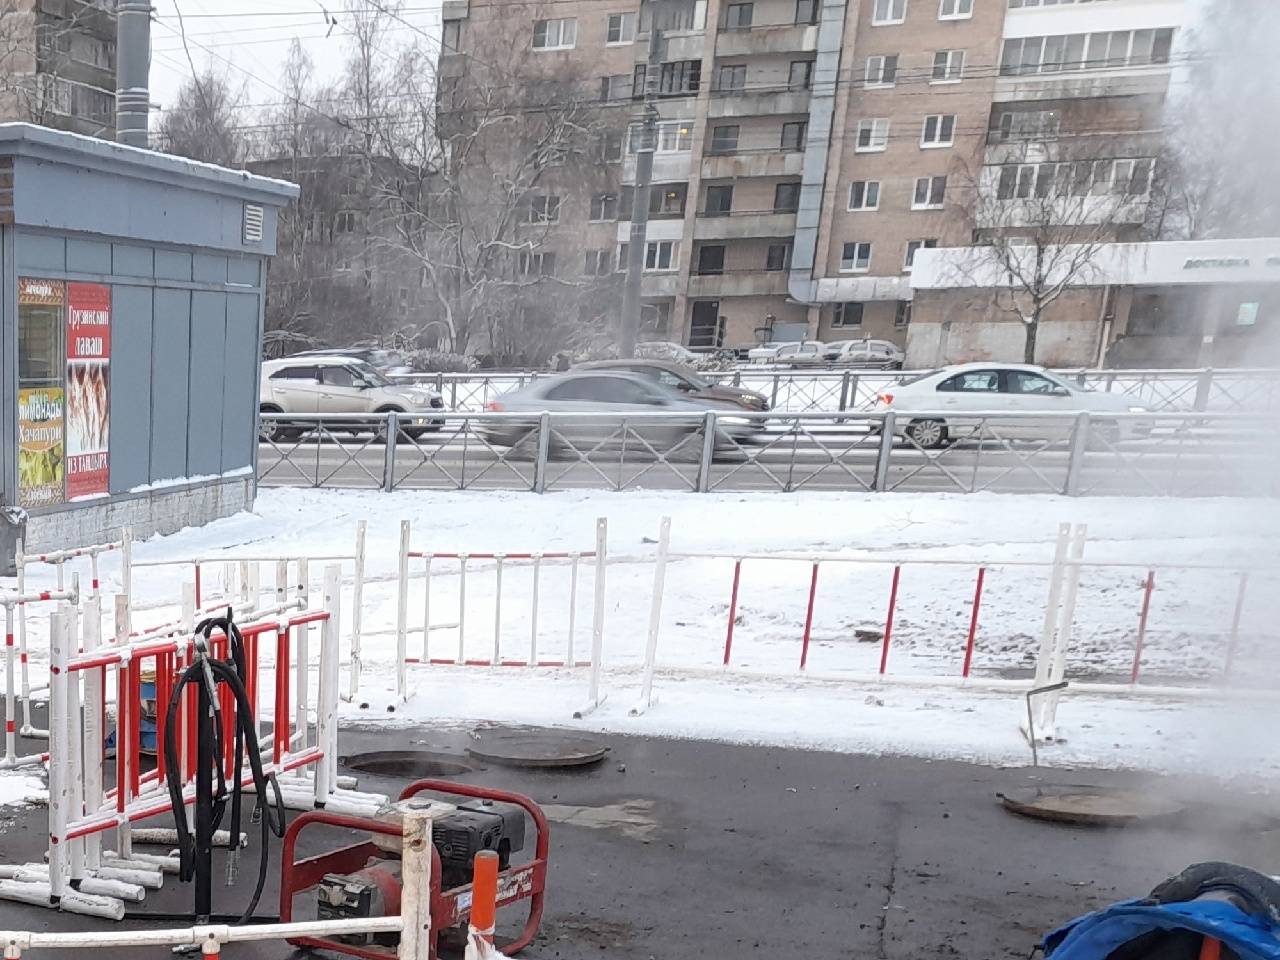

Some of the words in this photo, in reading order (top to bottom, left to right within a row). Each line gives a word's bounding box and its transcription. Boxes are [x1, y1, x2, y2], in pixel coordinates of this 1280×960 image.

[68, 304, 109, 330] Грузинский
[75, 336, 103, 356] лаваш
[18, 424, 62, 445] Хачапури
